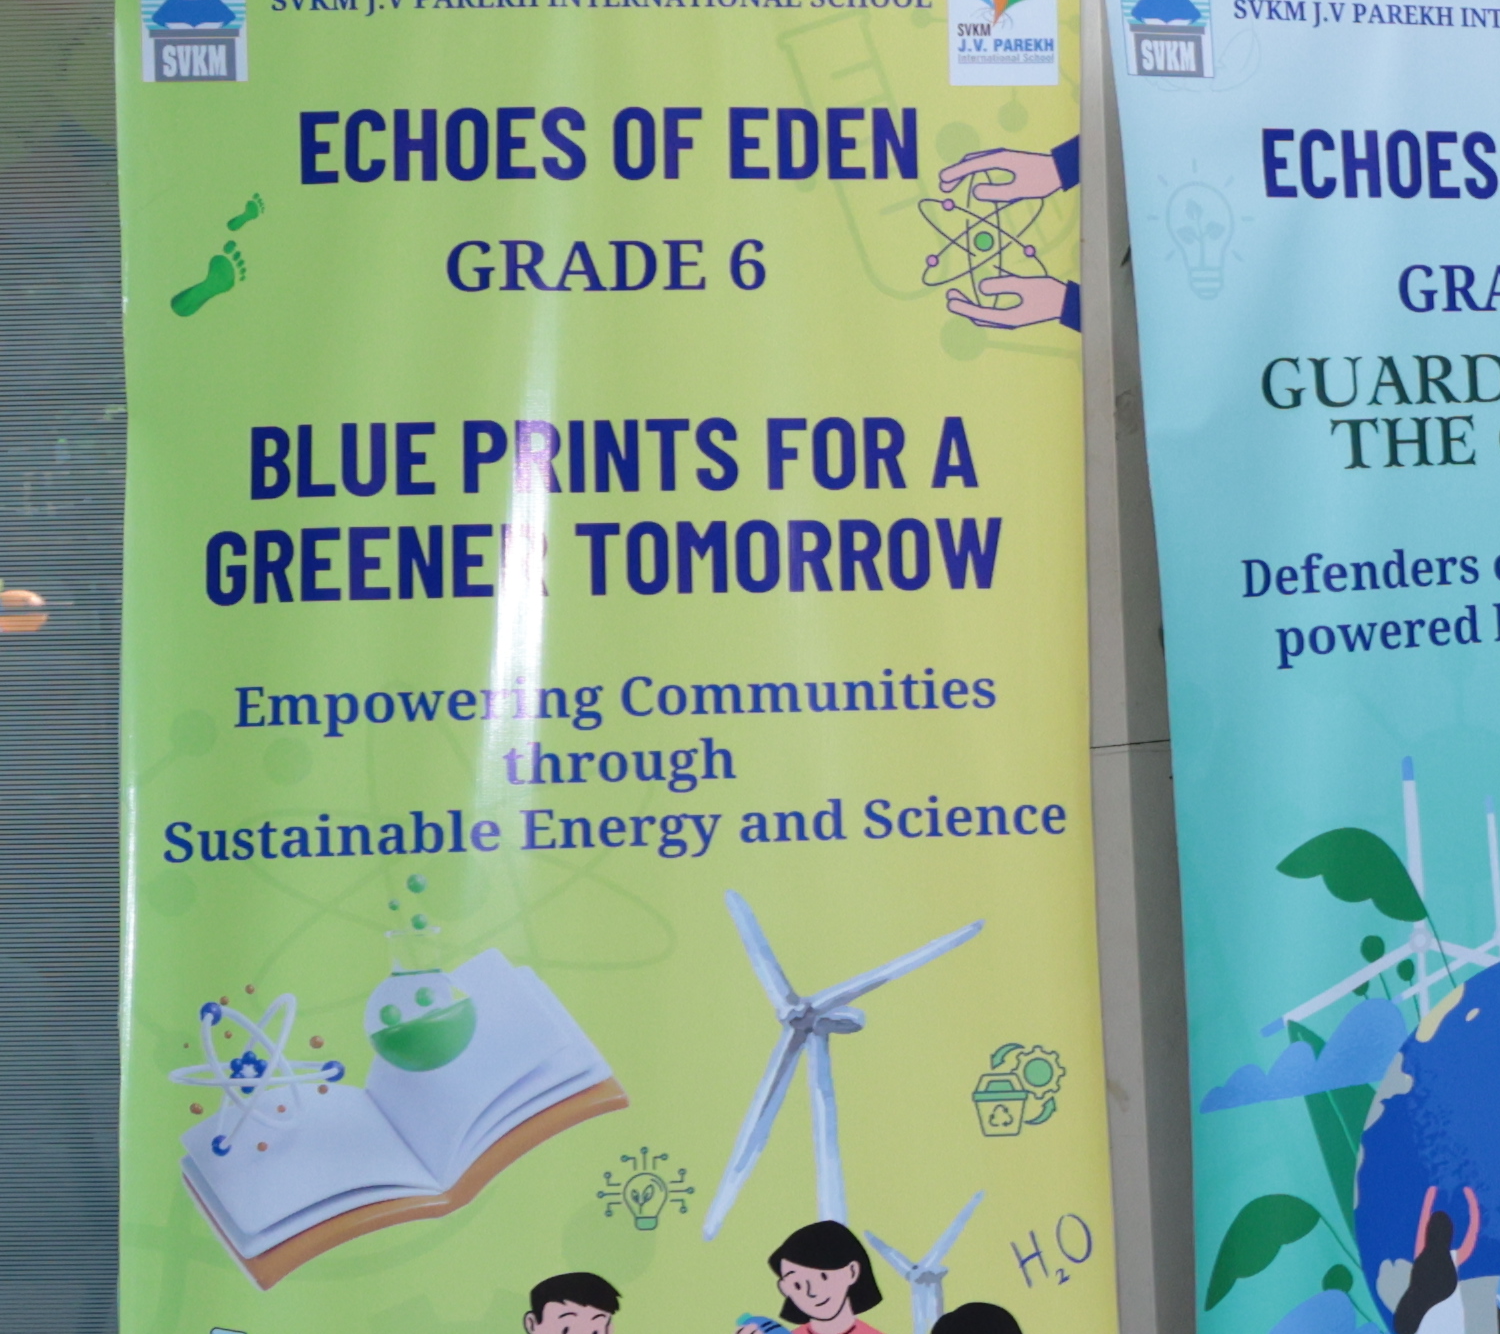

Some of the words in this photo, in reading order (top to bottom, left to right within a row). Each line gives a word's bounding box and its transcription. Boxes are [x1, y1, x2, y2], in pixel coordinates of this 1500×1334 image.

[958, 23, 991, 37] SVKM
[1233, 0, 1307, 21] SVKM
[1312, 2, 1345, 28] J.V
[1353, 3, 1454, 27] PAREKH
[162, 45, 228, 77] SVKM
[958, 38, 987, 52] J.V.
[994, 38, 1054, 52] PAREKH
[1141, 39, 1197, 71] SVKM
[299, 106, 587, 185] ECHOES
[613, 106, 702, 181] OF
[729, 107, 918, 181] EDEN
[1262, 128, 1498, 200] ECHOES
[446, 239, 706, 293] GRADE
[730, 238, 766, 292] 6
[250, 422, 435, 501] BLUE
[463, 418, 739, 495] PRINTS
[767, 417, 906, 490] FOR
[931, 417, 979, 488] A
[1331, 415, 1476, 470] THE
[576, 517, 1002, 595] TOMORROW
[1242, 550, 1480, 599] Defenders
[1277, 605, 1481, 670] powered
[234, 677, 603, 737] Empowering
[621, 668, 997, 716] Communities
[504, 738, 736, 793] through
[163, 809, 501, 864] Sustainable
[519, 808, 721, 859] Energy
[740, 799, 847, 843] and
[863, 795, 1067, 840] Science
